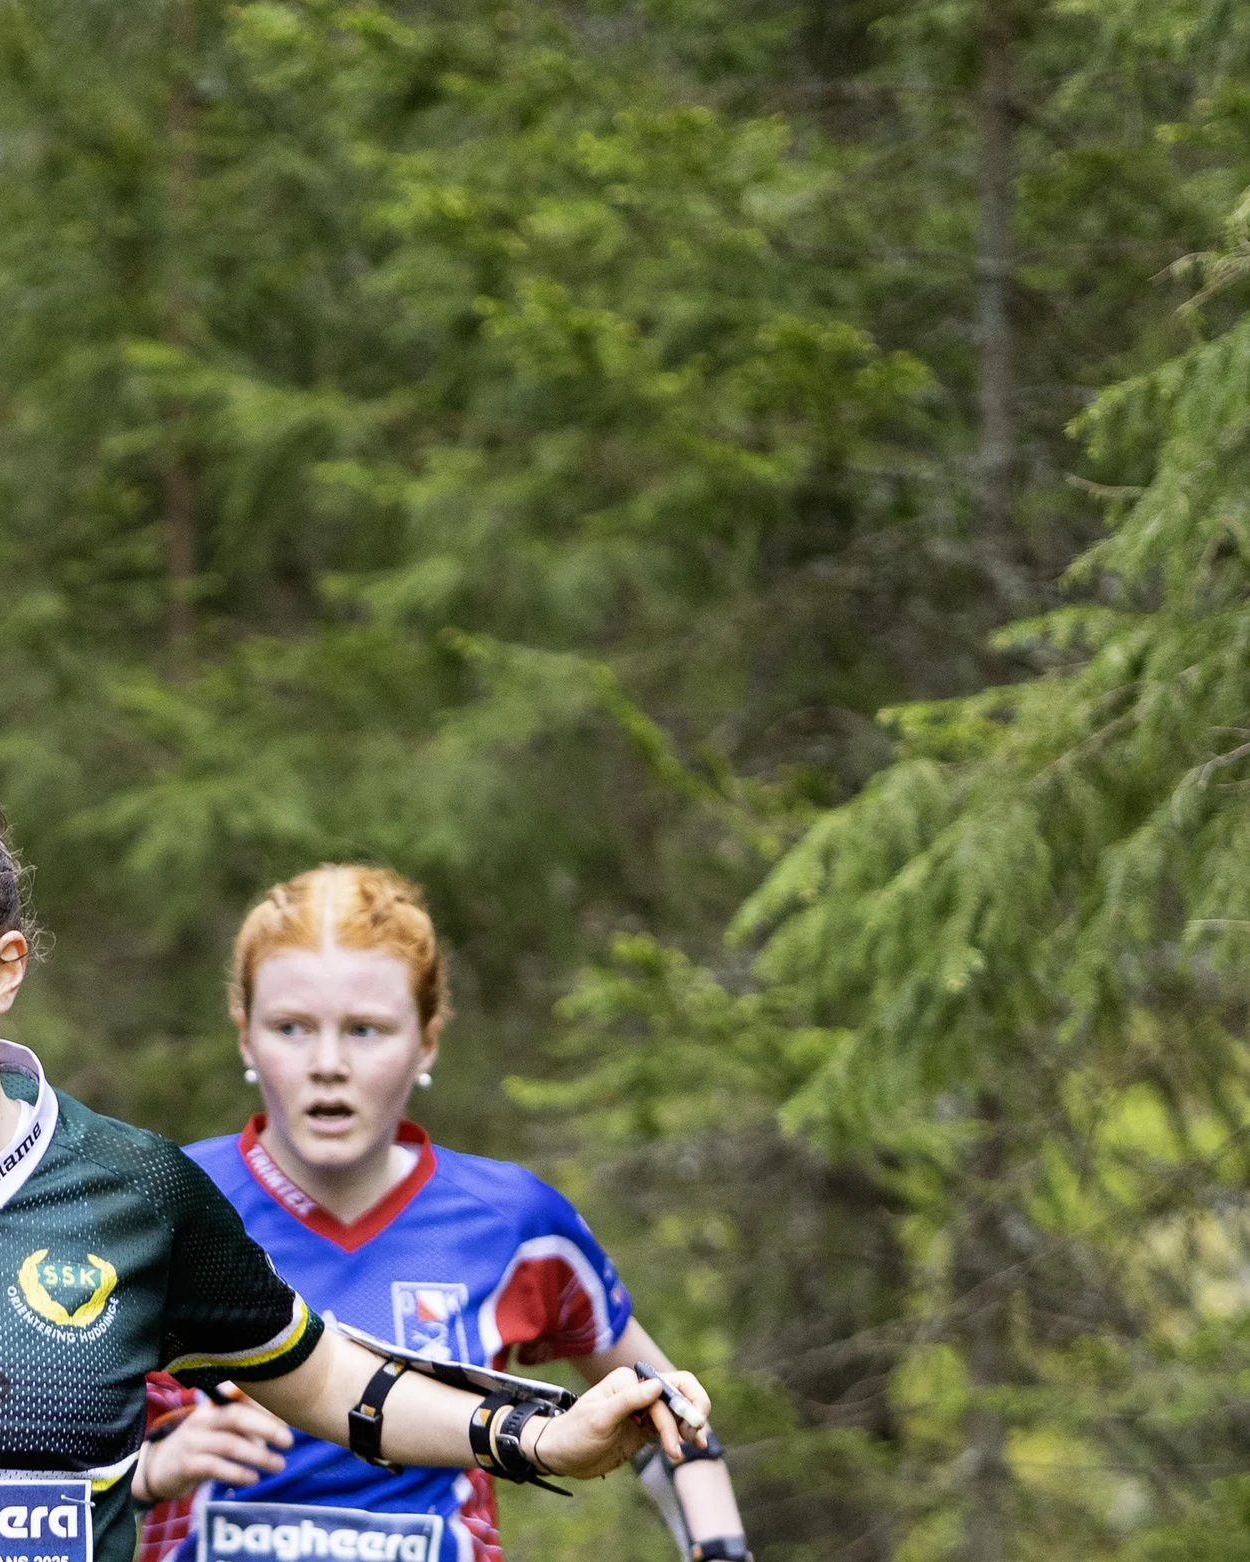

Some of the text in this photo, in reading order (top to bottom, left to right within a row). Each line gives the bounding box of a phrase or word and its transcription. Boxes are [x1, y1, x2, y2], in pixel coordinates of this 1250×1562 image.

[43, 1264, 97, 1288] SSK
[7, 1285, 120, 1343] ORIENTERING HUDDINGE
